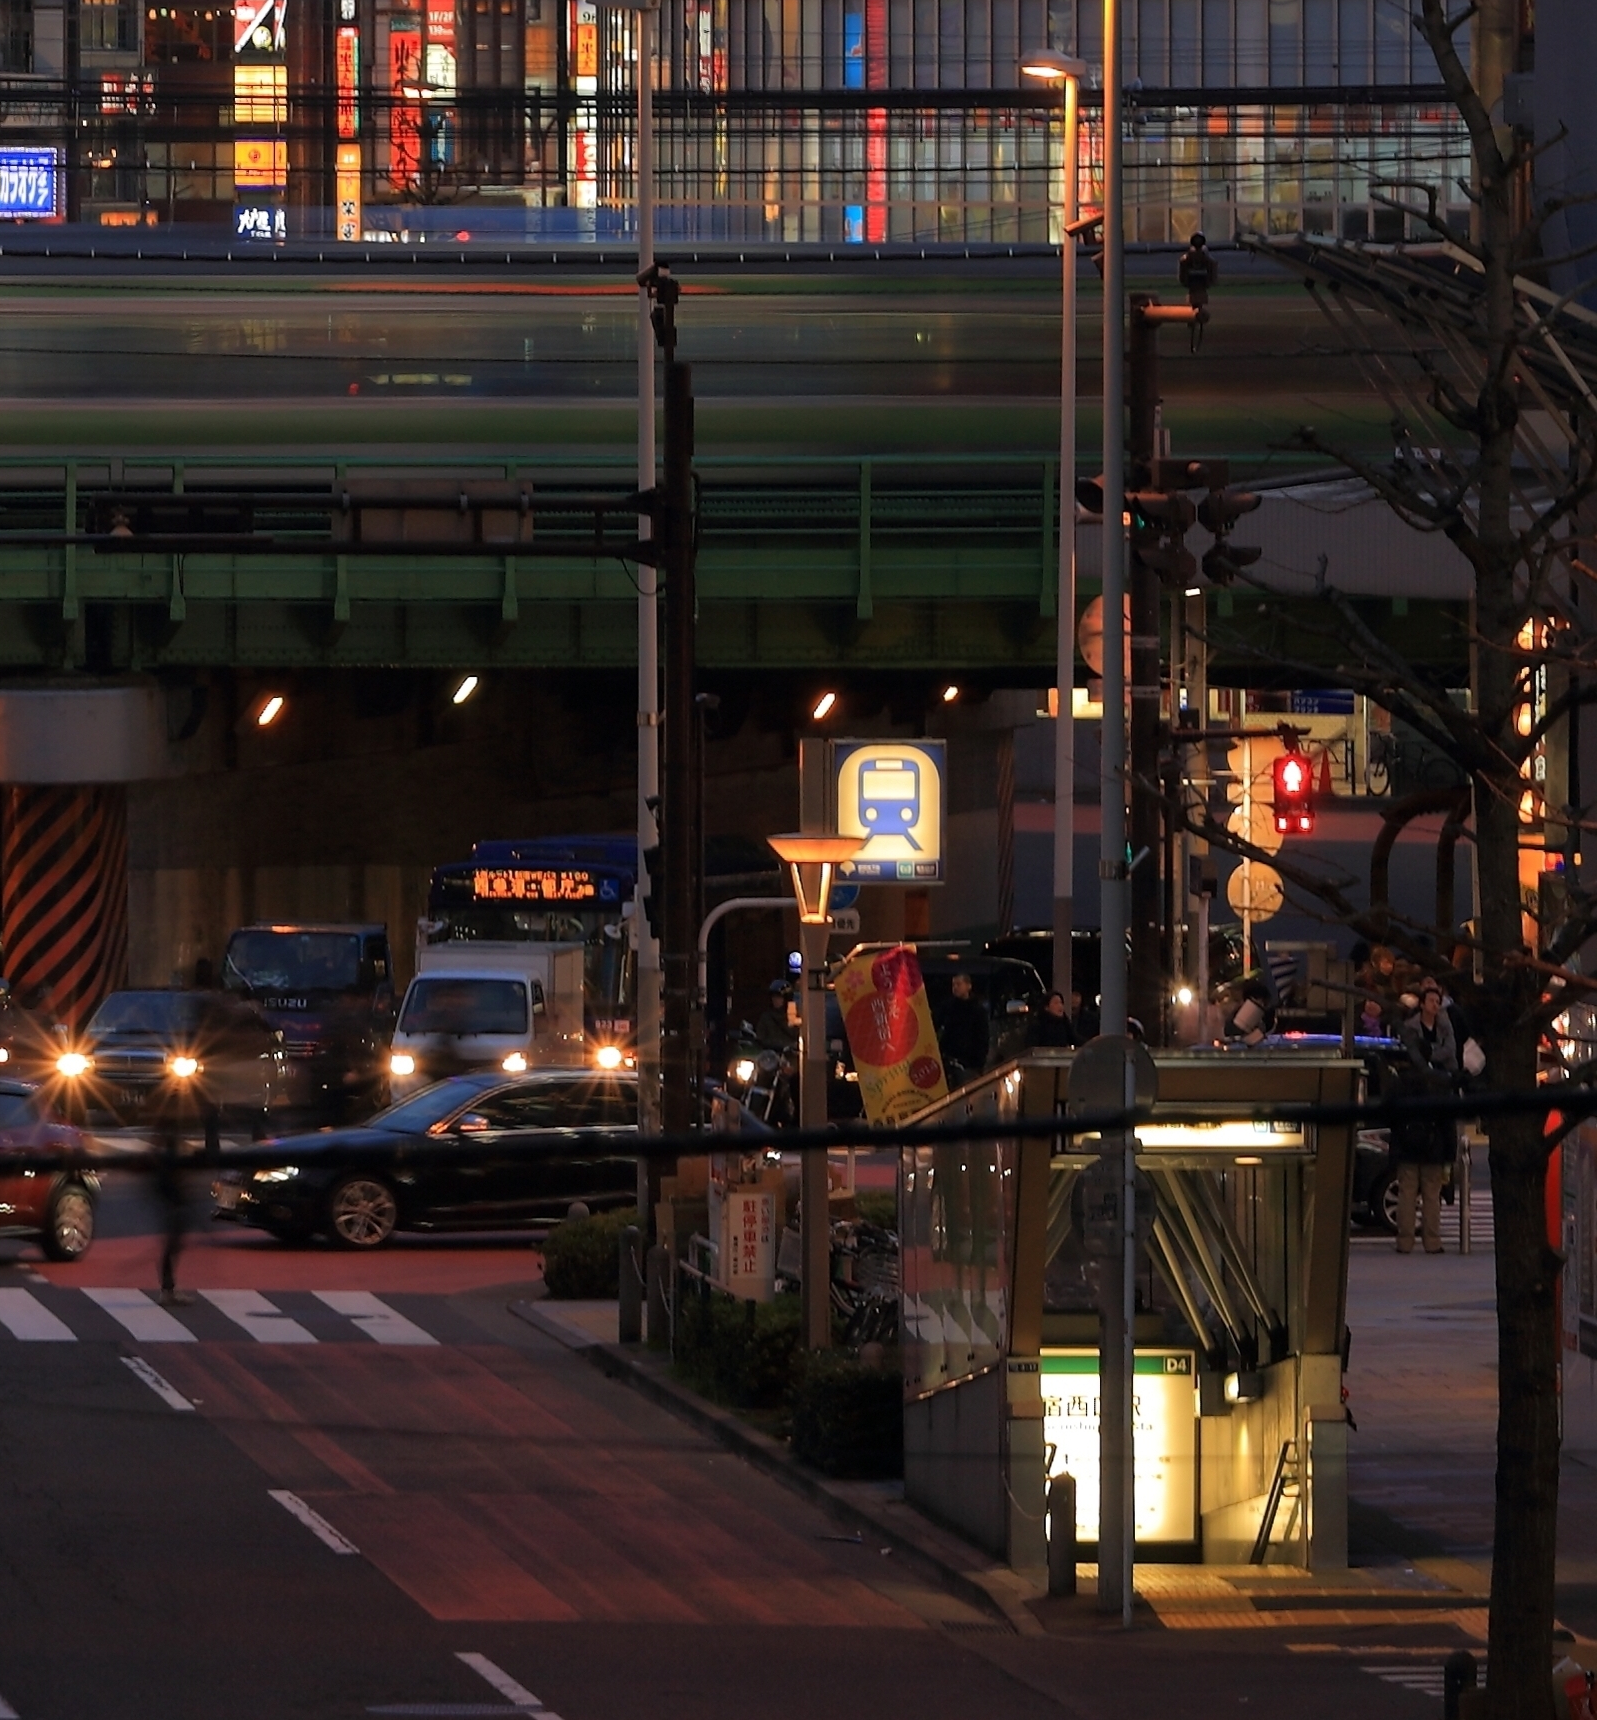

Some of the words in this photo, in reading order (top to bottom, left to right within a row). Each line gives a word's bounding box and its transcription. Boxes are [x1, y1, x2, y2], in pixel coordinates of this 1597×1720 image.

[263, 998, 307, 1008] ISUZU
[743, 1200, 756, 1273] 駐停車禁止
[1167, 1358, 1186, 1372] D4
